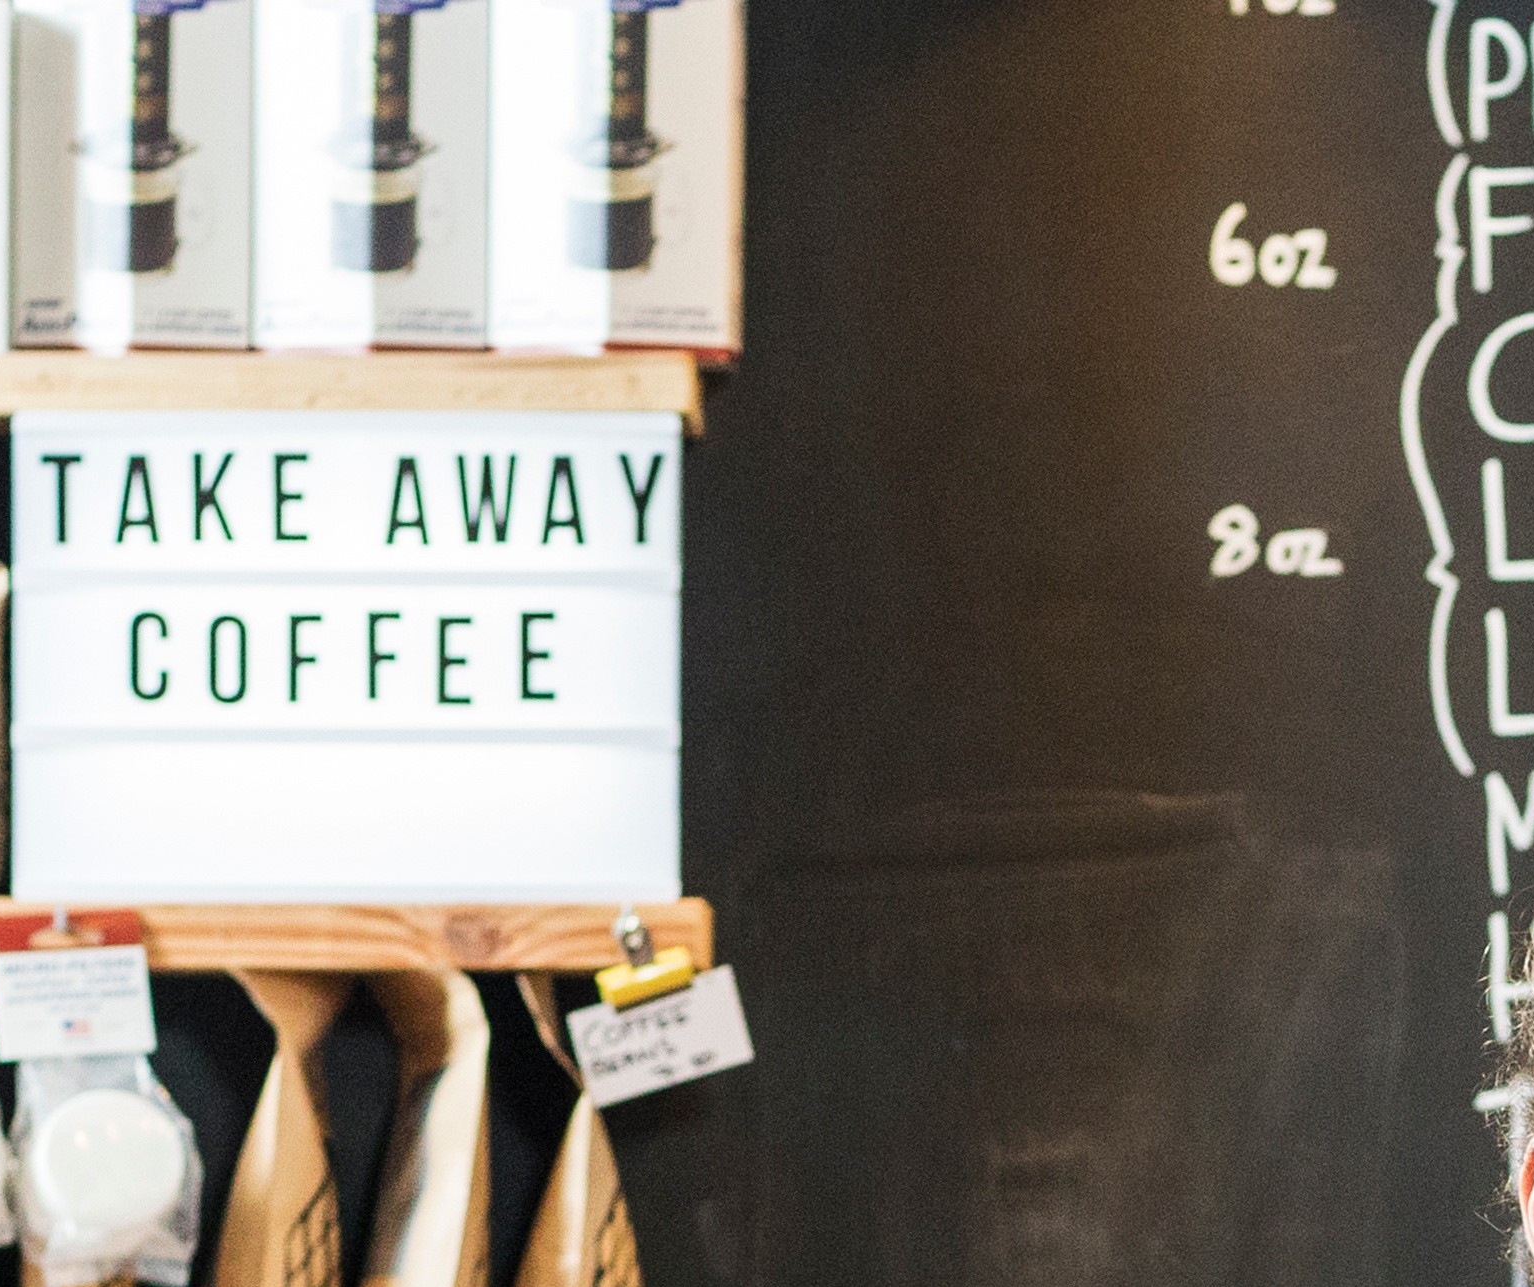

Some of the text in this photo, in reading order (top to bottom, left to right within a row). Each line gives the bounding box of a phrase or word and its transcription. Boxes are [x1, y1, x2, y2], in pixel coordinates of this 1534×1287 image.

[40, 452, 665, 545] TAKE AWAY
[129, 611, 557, 705] COFFEE
